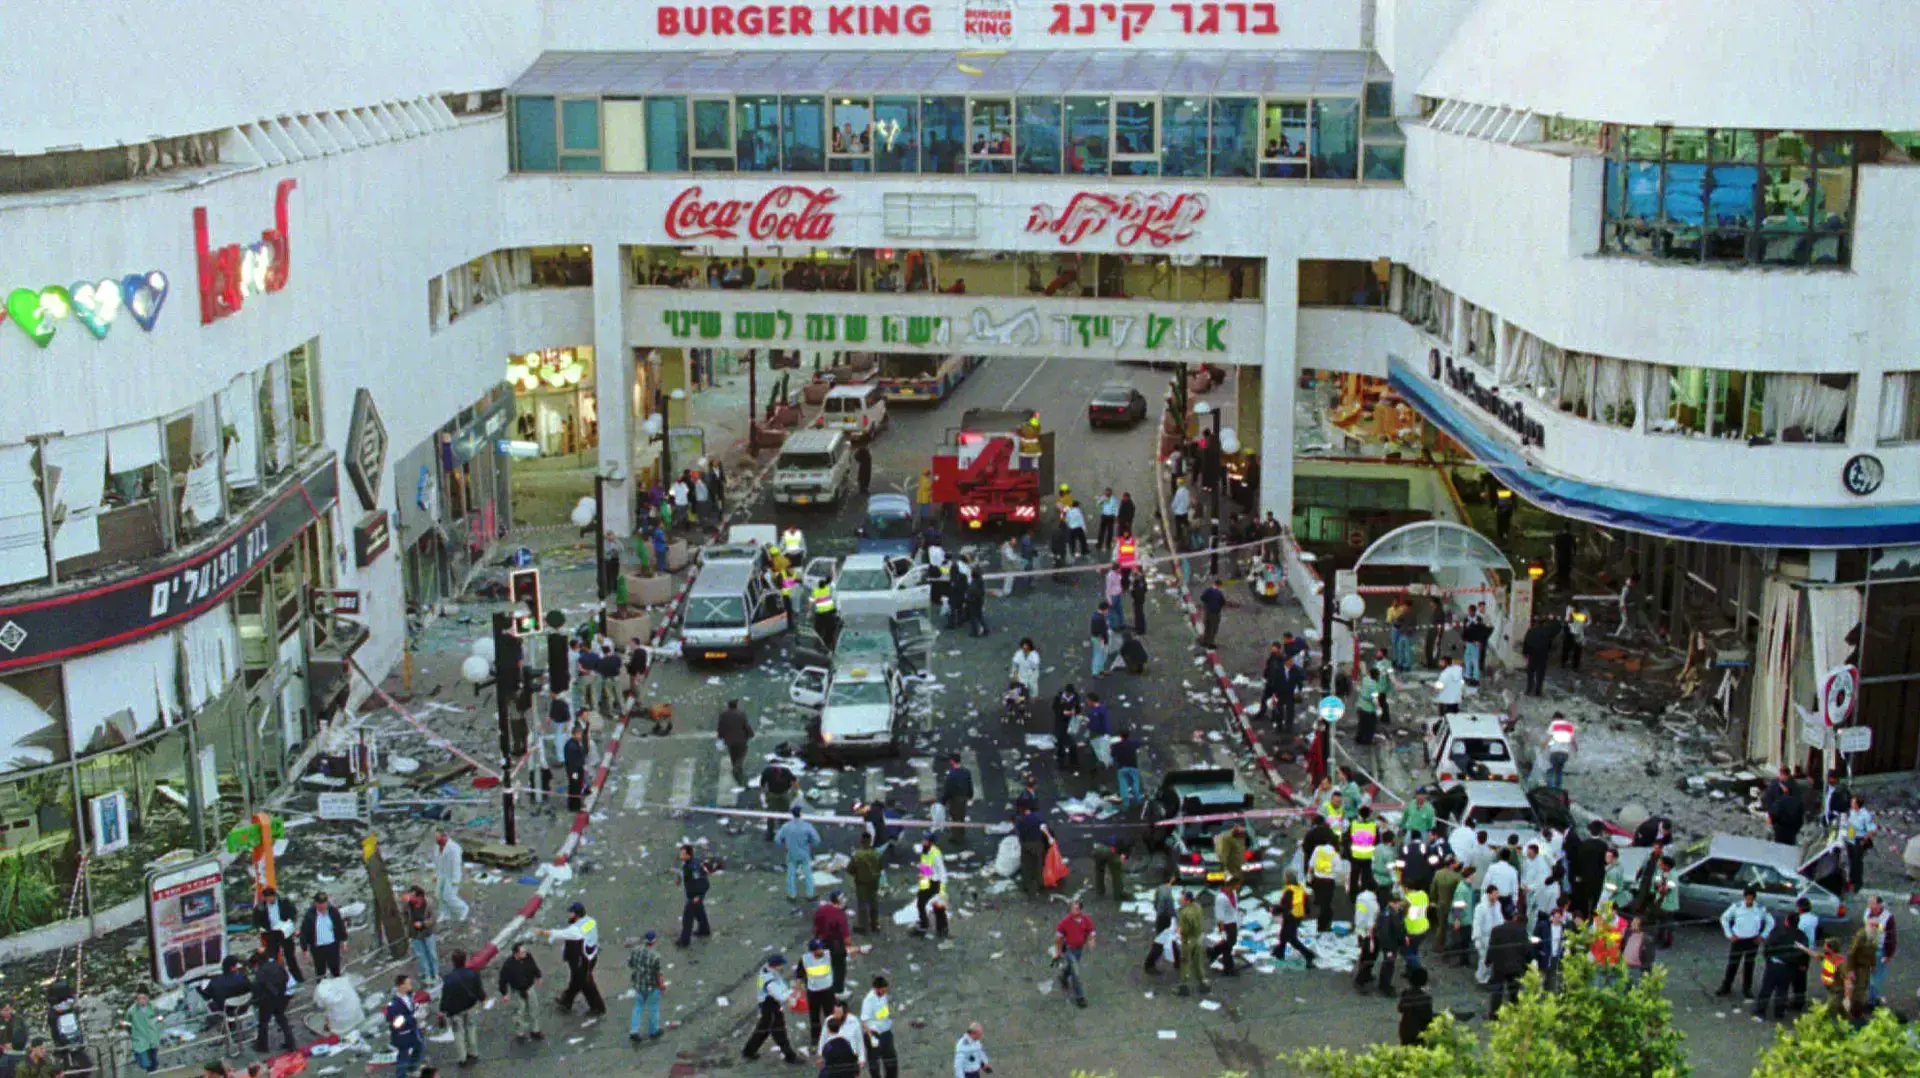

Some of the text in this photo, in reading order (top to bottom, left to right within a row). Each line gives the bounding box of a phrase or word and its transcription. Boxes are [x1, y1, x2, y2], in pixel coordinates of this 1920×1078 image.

[657, 4, 931, 36] BURGER KING
[964, 8, 1012, 20] BURGER
[964, 21, 1012, 35] KING
[1048, 3, 1279, 41] ברגר קינג
[665, 185, 841, 241] Coca-Cola
[663, 310, 721, 338] שינוי
[735, 310, 792, 340] לשם
[150, 543, 239, 618] הפועלים
